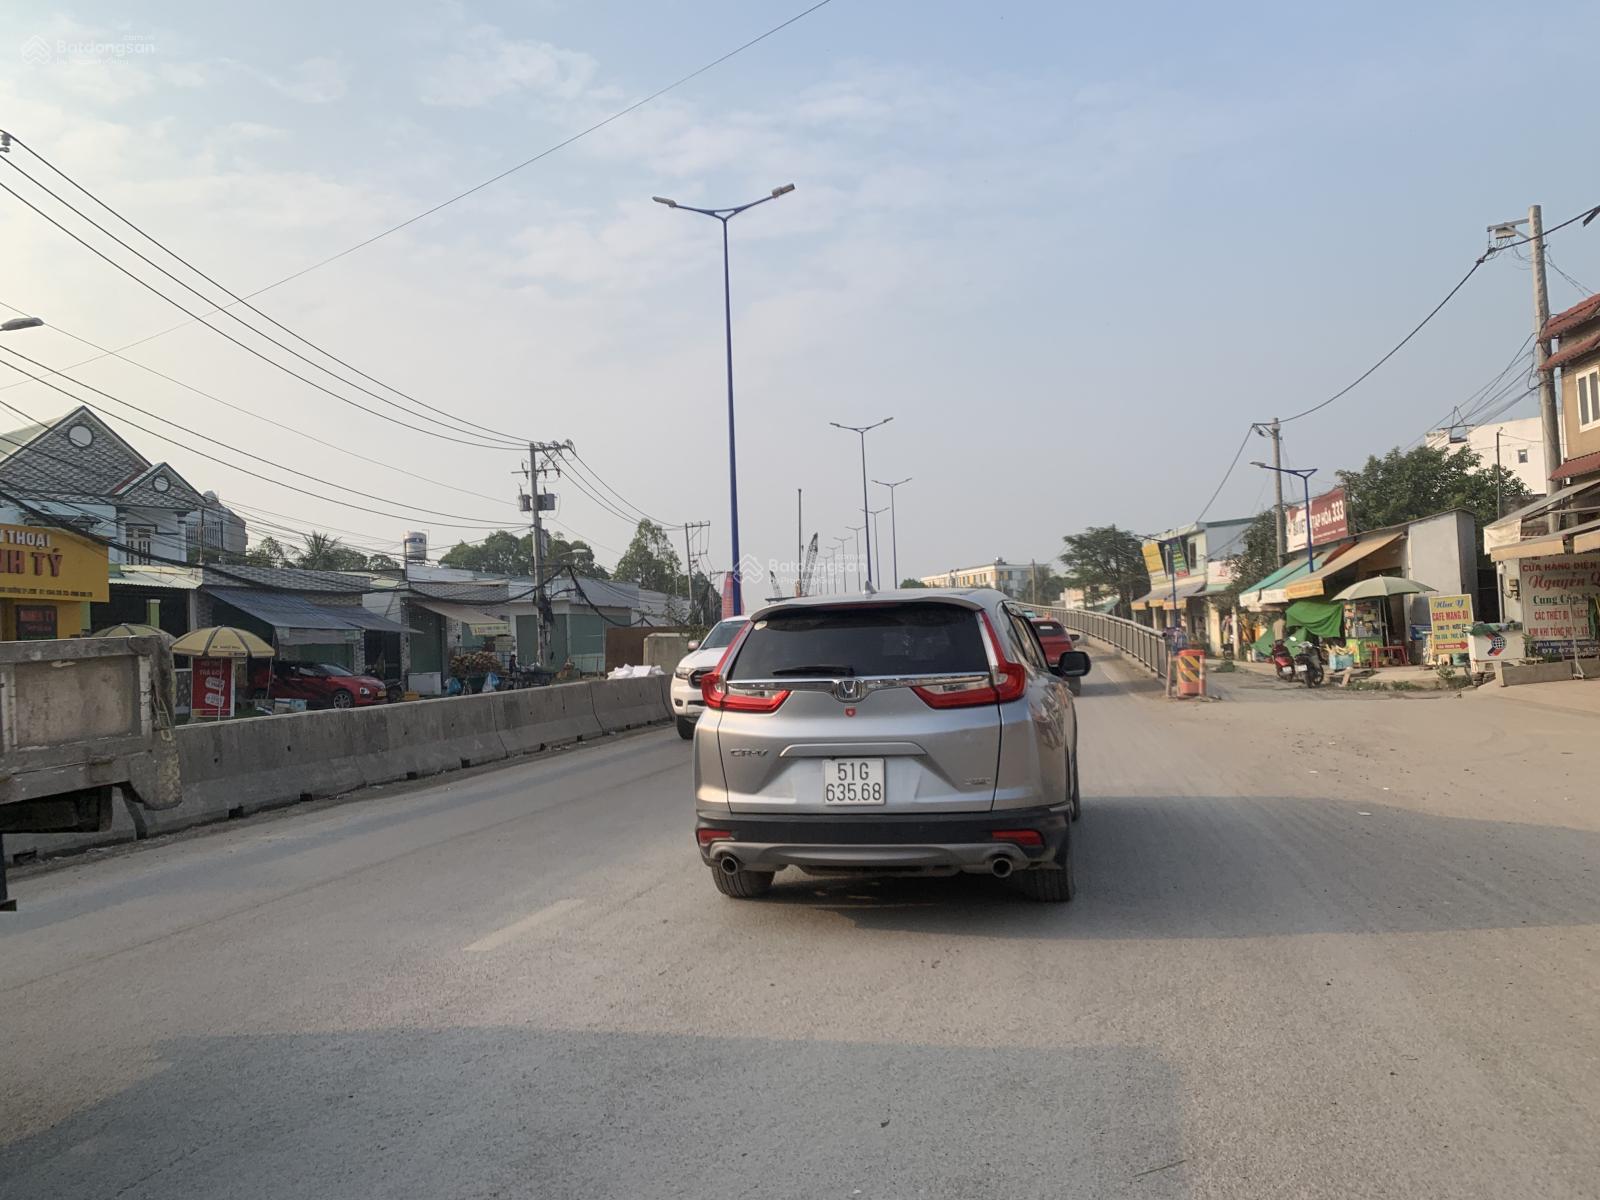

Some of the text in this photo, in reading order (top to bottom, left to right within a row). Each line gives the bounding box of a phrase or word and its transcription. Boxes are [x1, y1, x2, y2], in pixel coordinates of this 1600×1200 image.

[1331, 499, 1344, 523] 333
[730, 749, 769, 758] CR-V
[837, 762, 870, 781] 51G
[825, 782, 883, 803] 635.68
